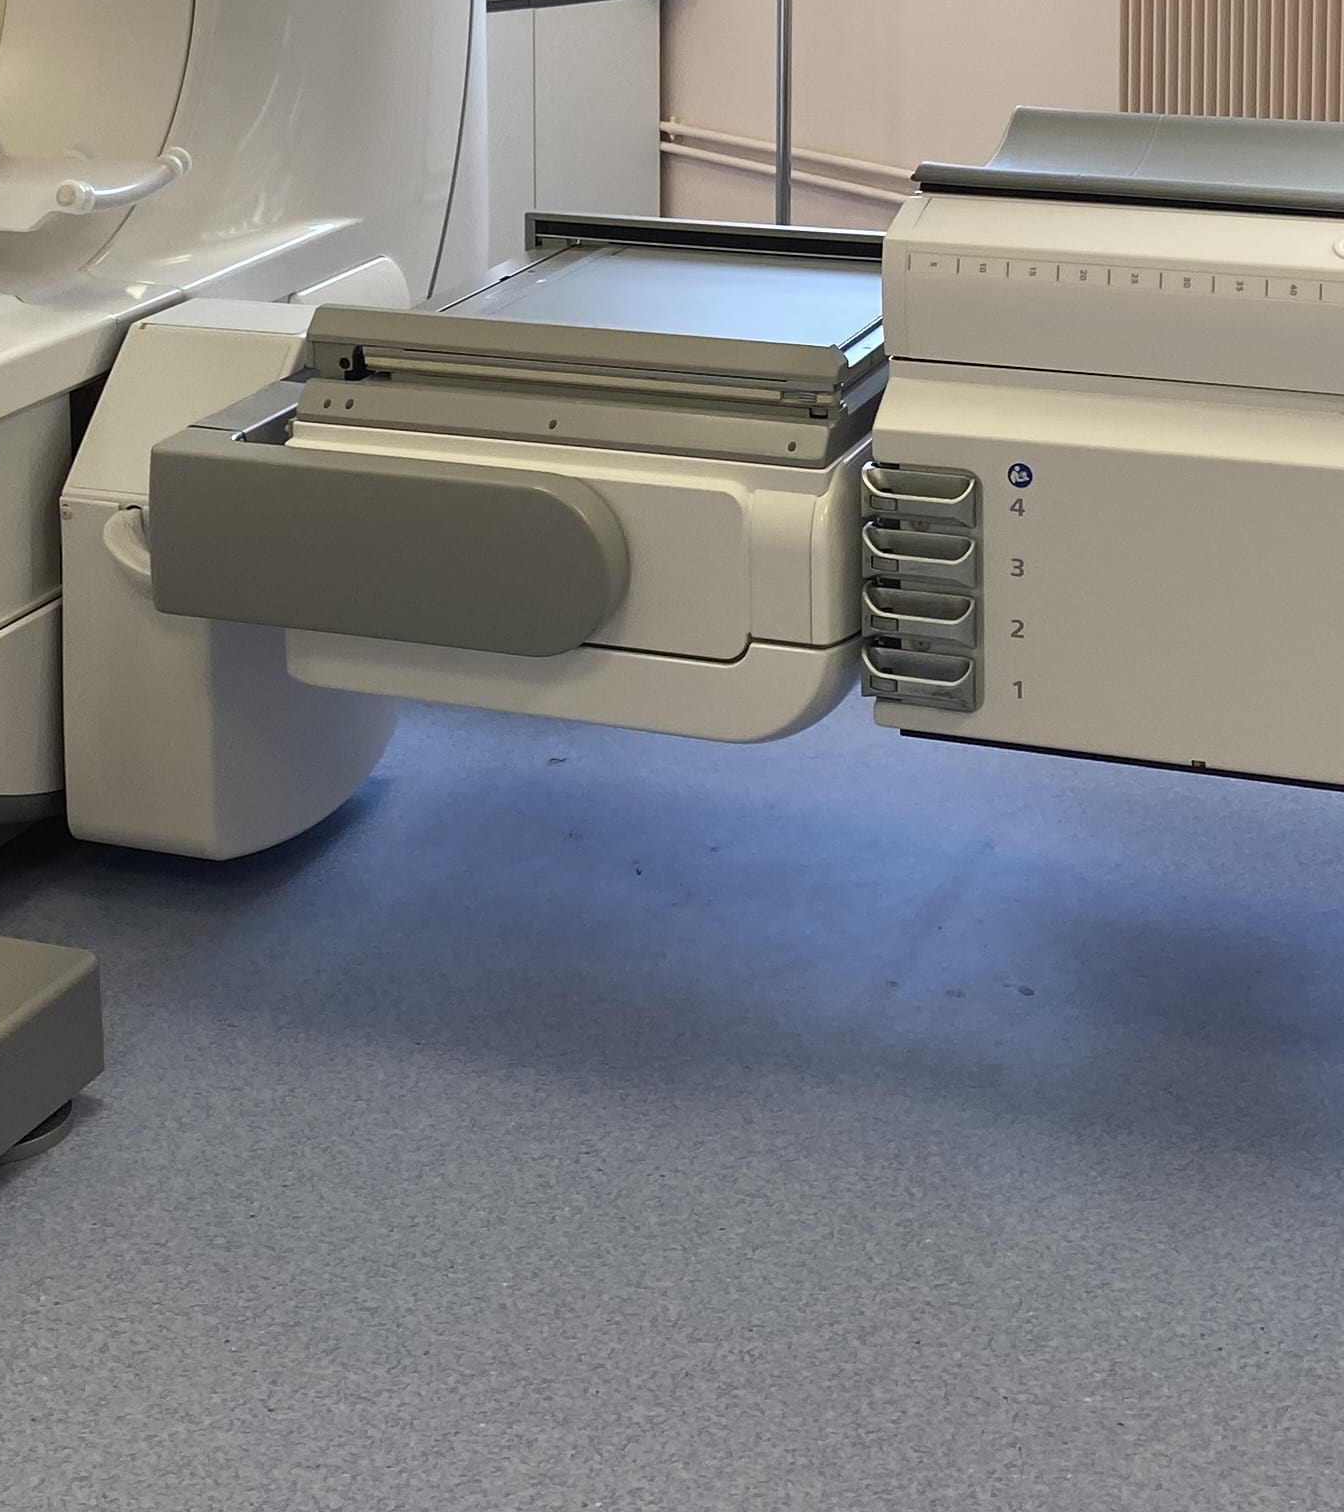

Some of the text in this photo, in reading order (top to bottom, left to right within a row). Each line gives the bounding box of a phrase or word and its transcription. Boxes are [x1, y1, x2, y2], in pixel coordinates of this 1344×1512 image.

[978, 262, 988, 274] 10
[1028, 266, 1037, 277] 15
[1079, 269, 1088, 282] 20
[1130, 272, 1140, 285] 25
[1183, 276, 1192, 289] 30
[1235, 280, 1245, 292] 35
[1289, 283, 1298, 297] 40
[1009, 497, 1026, 517] 4
[1010, 558, 1025, 577] 3
[1010, 619, 1025, 638] 2
[1012, 680, 1024, 699] 1
